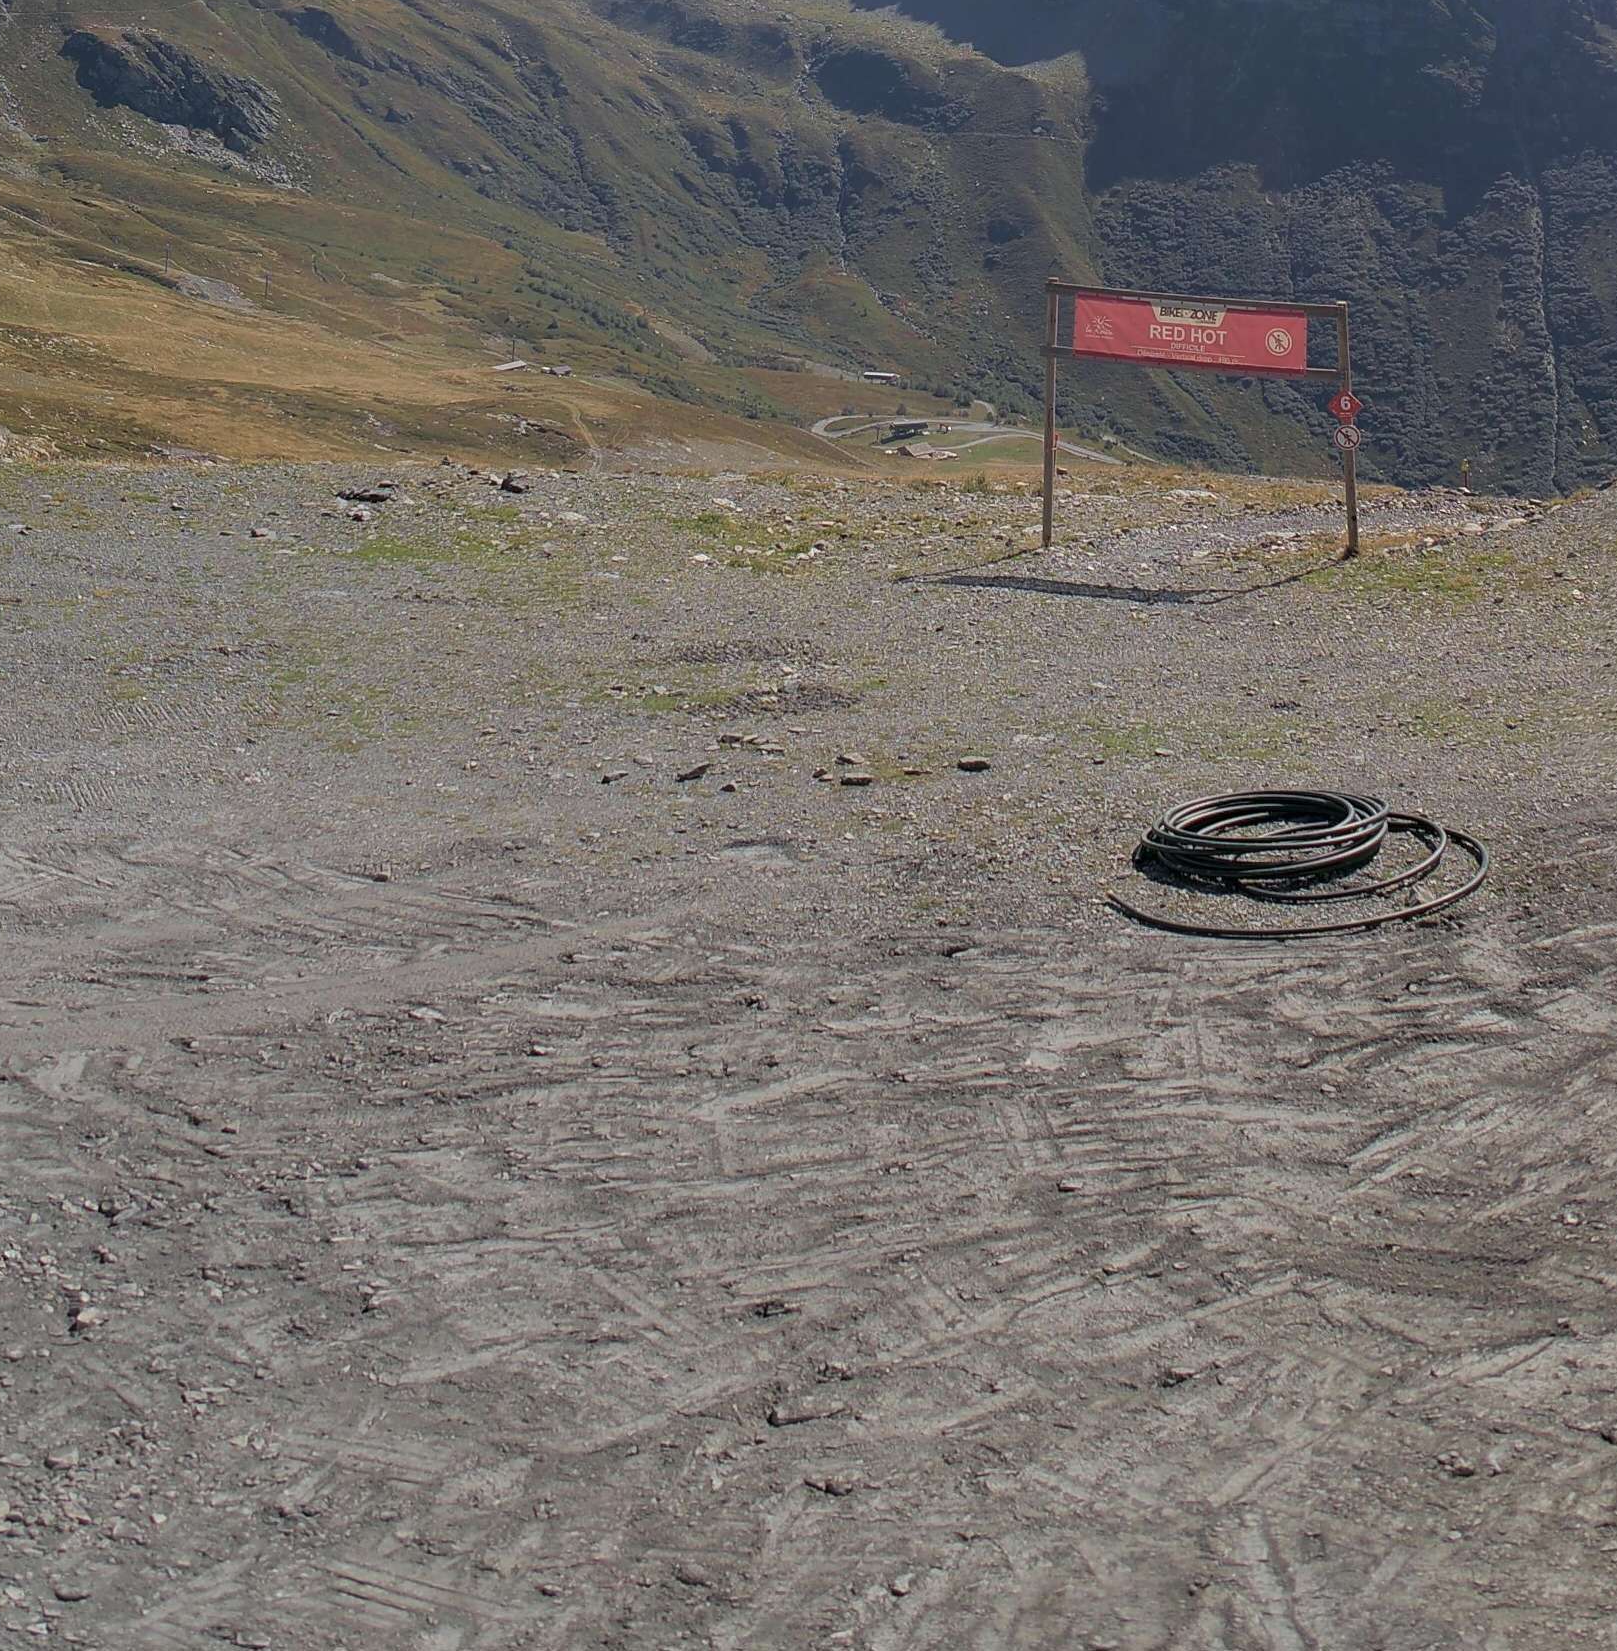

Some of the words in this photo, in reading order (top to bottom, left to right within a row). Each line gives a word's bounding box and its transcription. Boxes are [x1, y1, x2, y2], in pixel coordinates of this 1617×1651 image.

[1159, 306, 1183, 318] BIKE
[1190, 308, 1218, 322] ZONE
[1149, 324, 1187, 342] RED
[1190, 328, 1228, 346] HOT
[1340, 396, 1351, 411] 6
